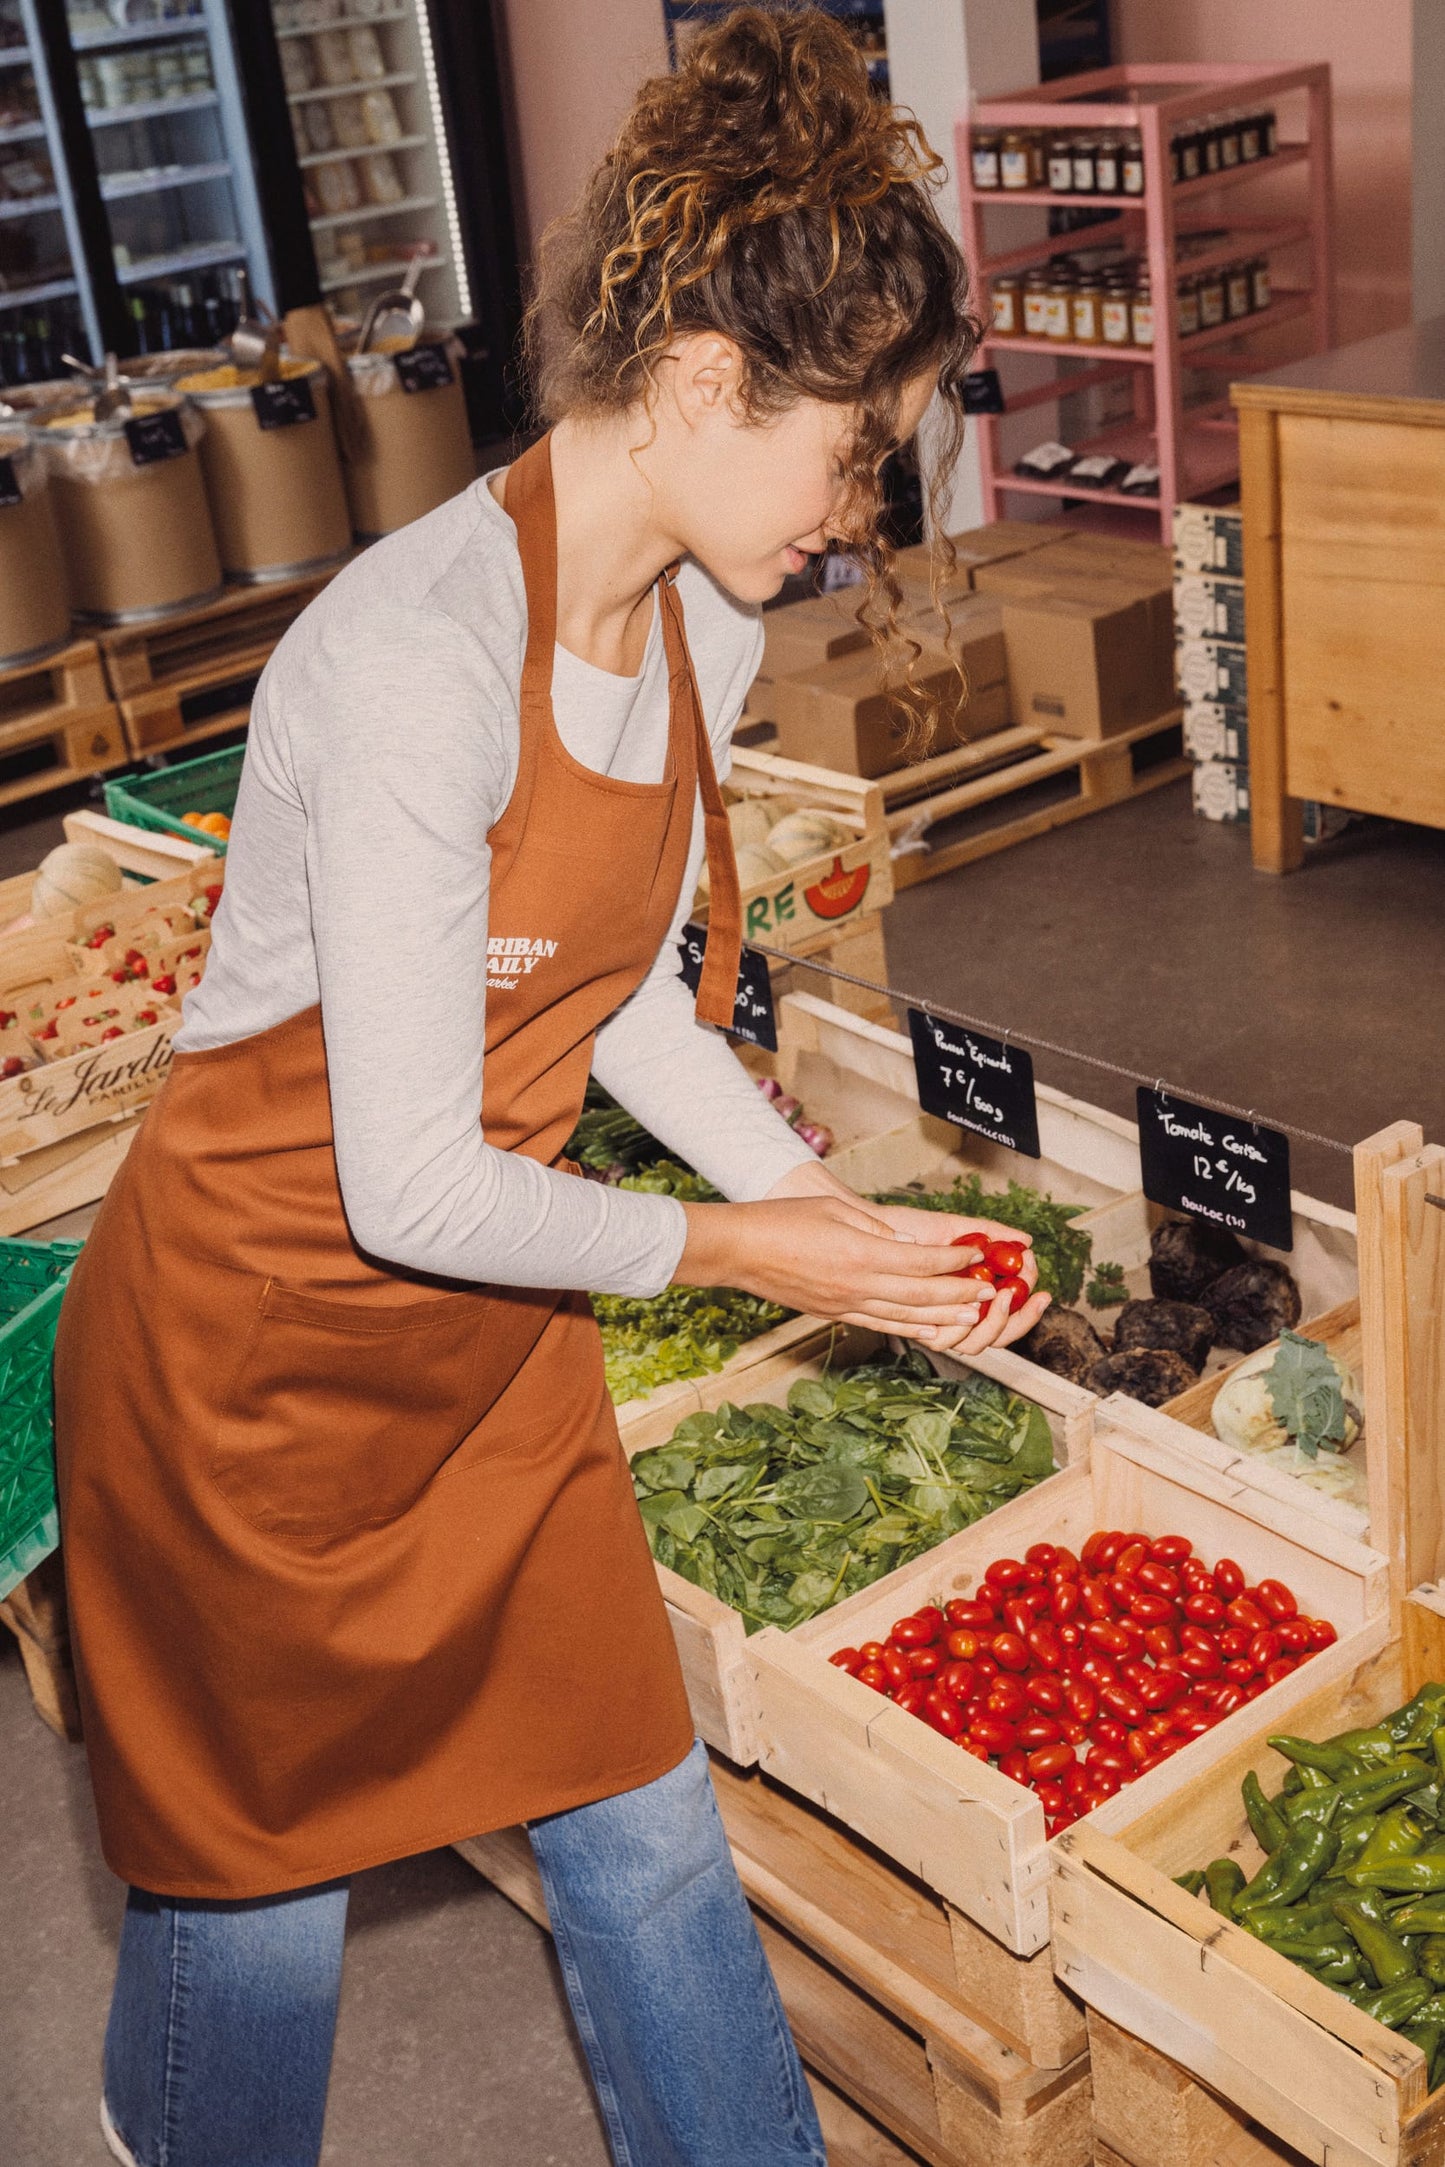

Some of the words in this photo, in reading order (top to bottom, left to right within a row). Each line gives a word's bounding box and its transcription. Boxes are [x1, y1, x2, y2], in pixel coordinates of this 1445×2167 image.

[485, 976, 519, 990] arket
[1158, 1113, 1215, 1147] Tomate
[1222, 1134, 1268, 1163] Cerise
